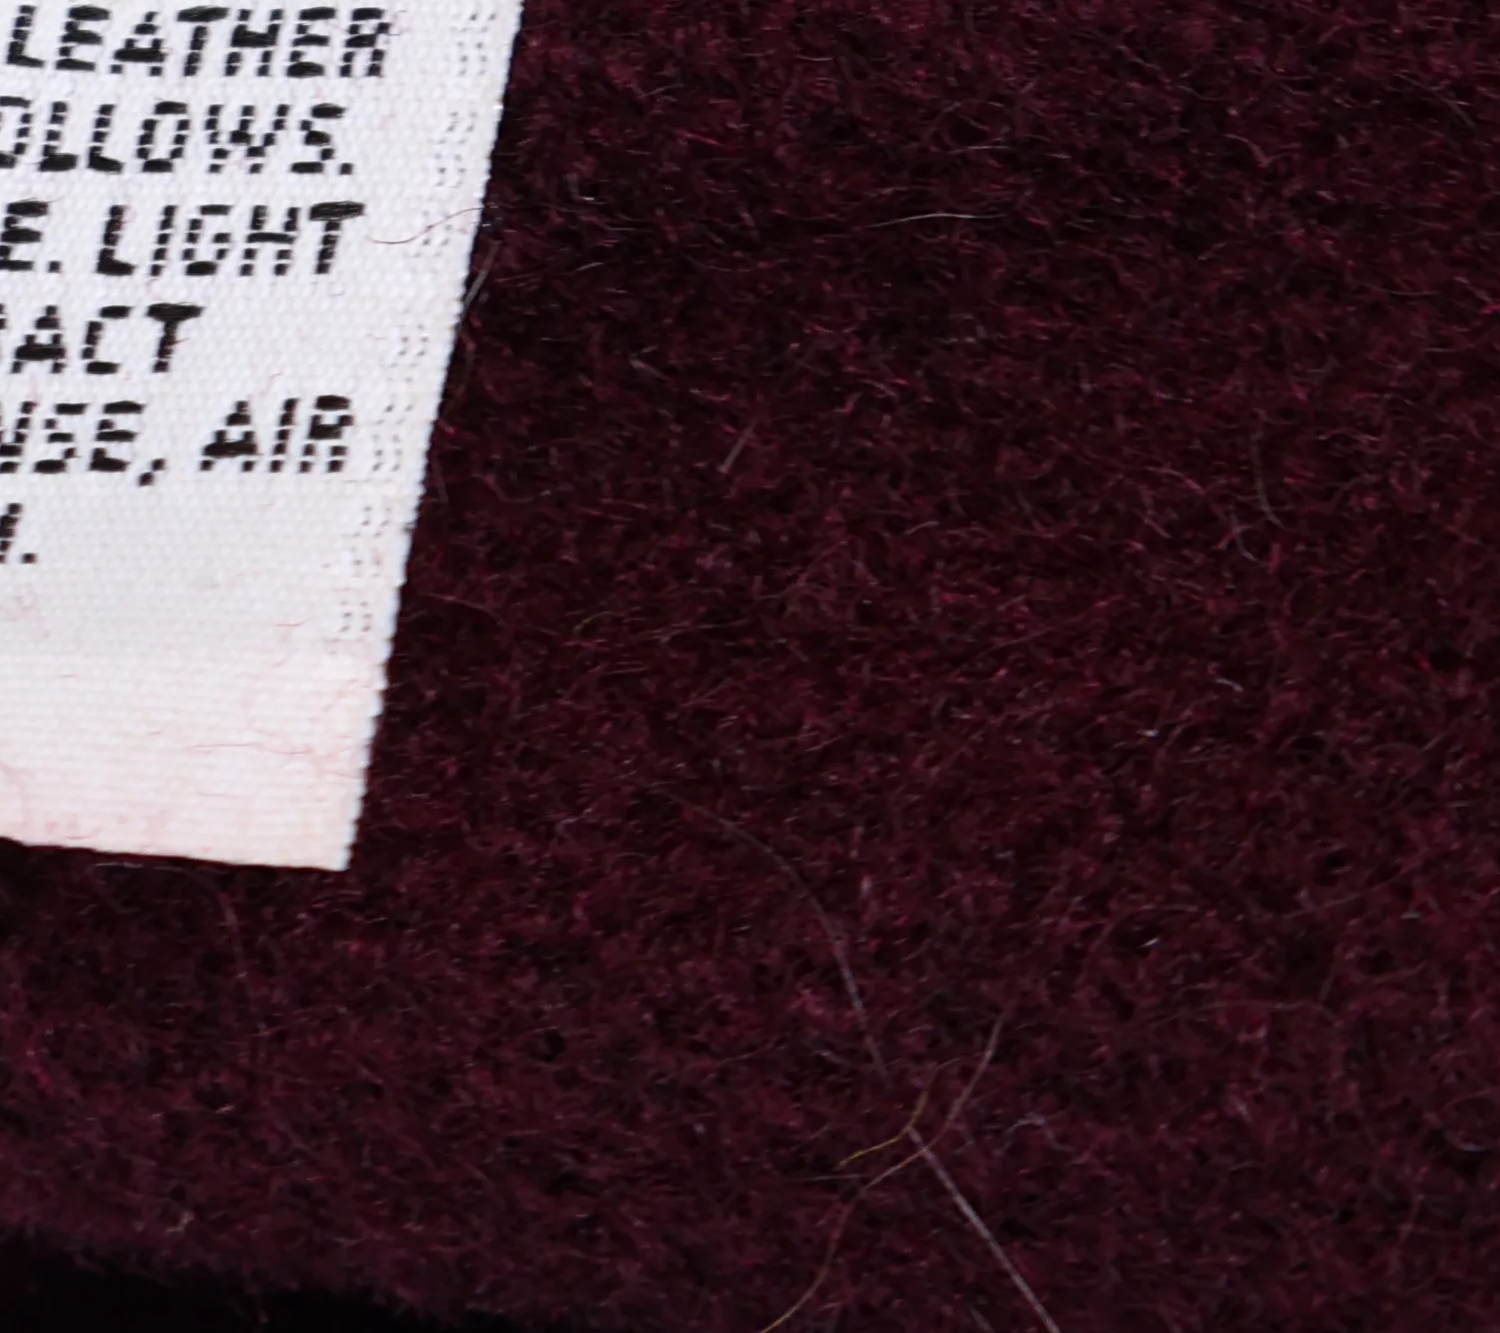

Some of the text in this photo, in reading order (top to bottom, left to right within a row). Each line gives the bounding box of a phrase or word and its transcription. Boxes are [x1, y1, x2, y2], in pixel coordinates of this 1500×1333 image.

[5, 4, 391, 78] LEATHER
[96, 200, 366, 277] LIGHT
[199, 394, 355, 475] AIR
